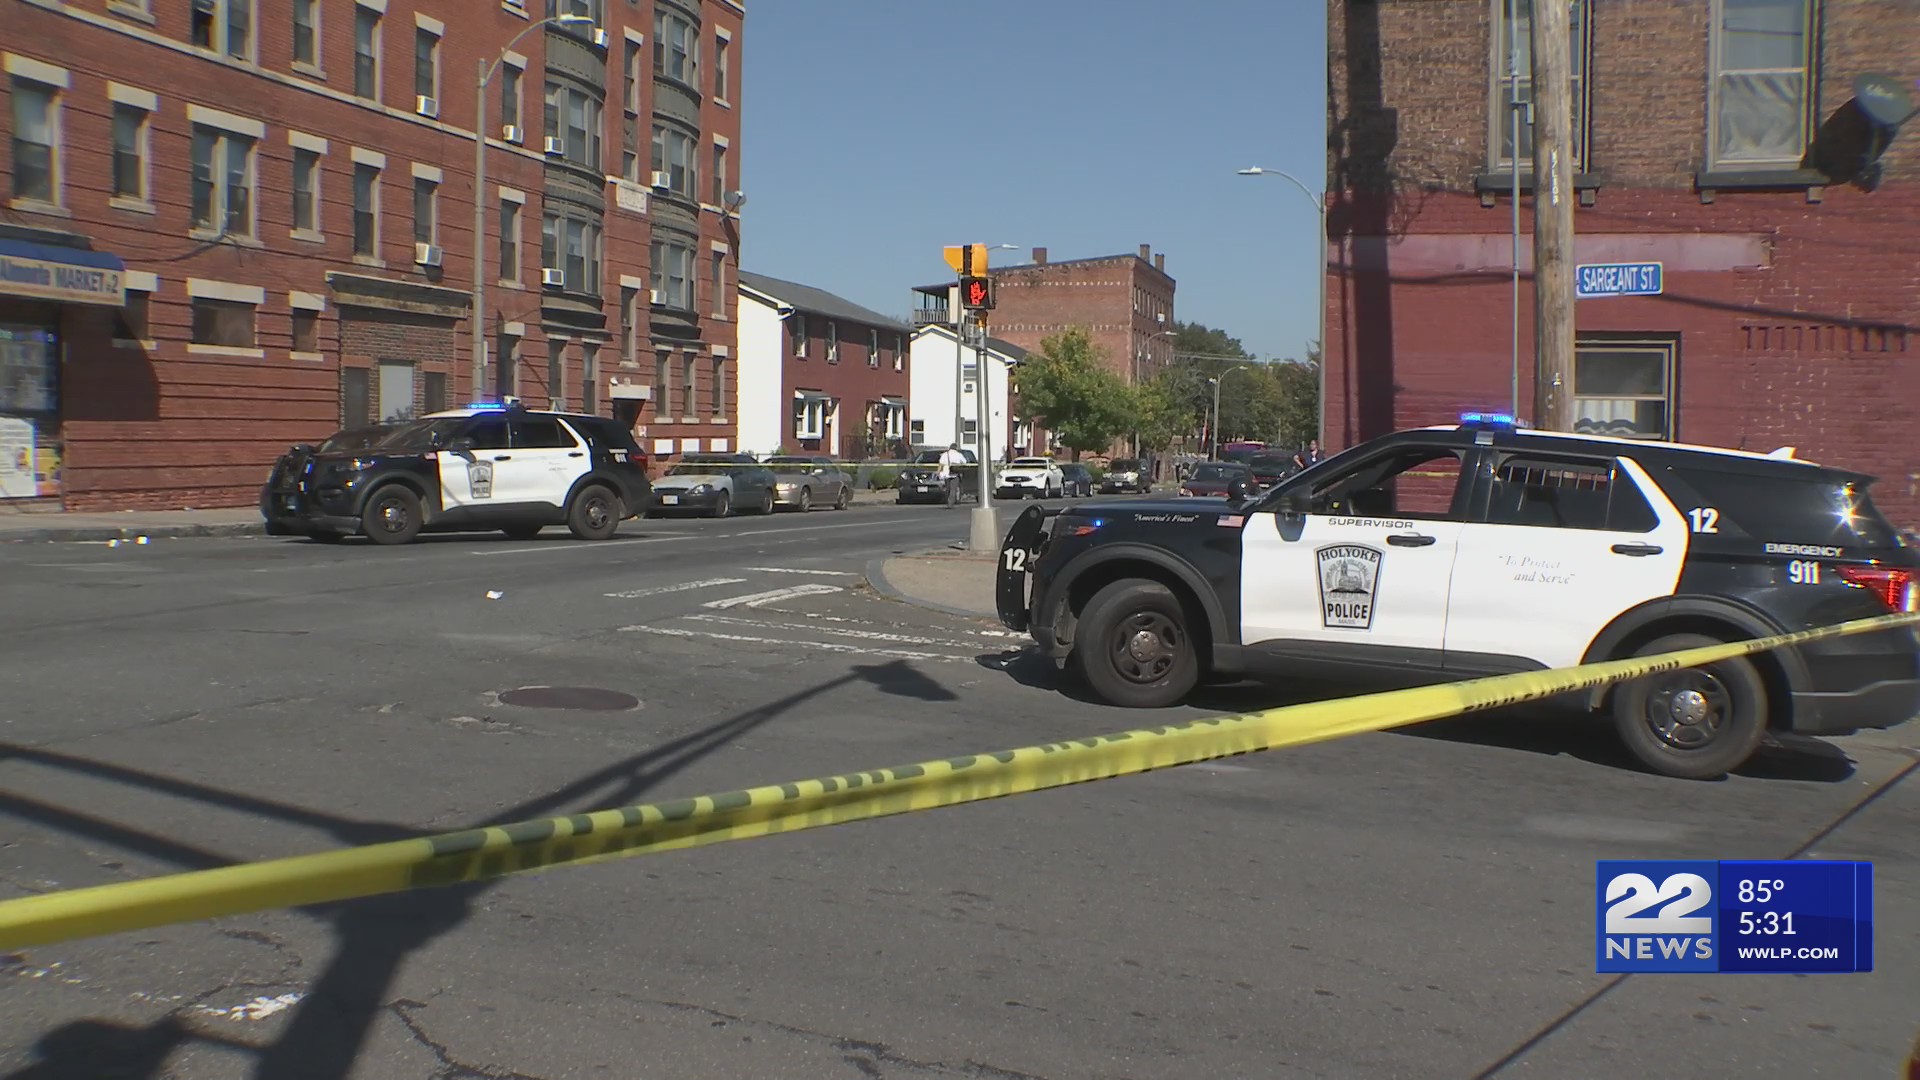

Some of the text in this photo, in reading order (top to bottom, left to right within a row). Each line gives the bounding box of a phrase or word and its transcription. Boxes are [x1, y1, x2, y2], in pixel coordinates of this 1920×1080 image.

[55, 267, 104, 291] MARKET
[1583, 266, 1657, 291] SARGEANT ST.
[1328, 517, 1414, 529] SUPERVISOR
[1688, 507, 1720, 534] 12
[1004, 548, 1026, 572] 12
[1320, 548, 1378, 563] HOLYOKE
[1764, 543, 1844, 557] EMERGENCY
[1513, 571, 1537, 582] and
[1789, 560, 1821, 585] 911
[1327, 603, 1368, 619] POLICE
